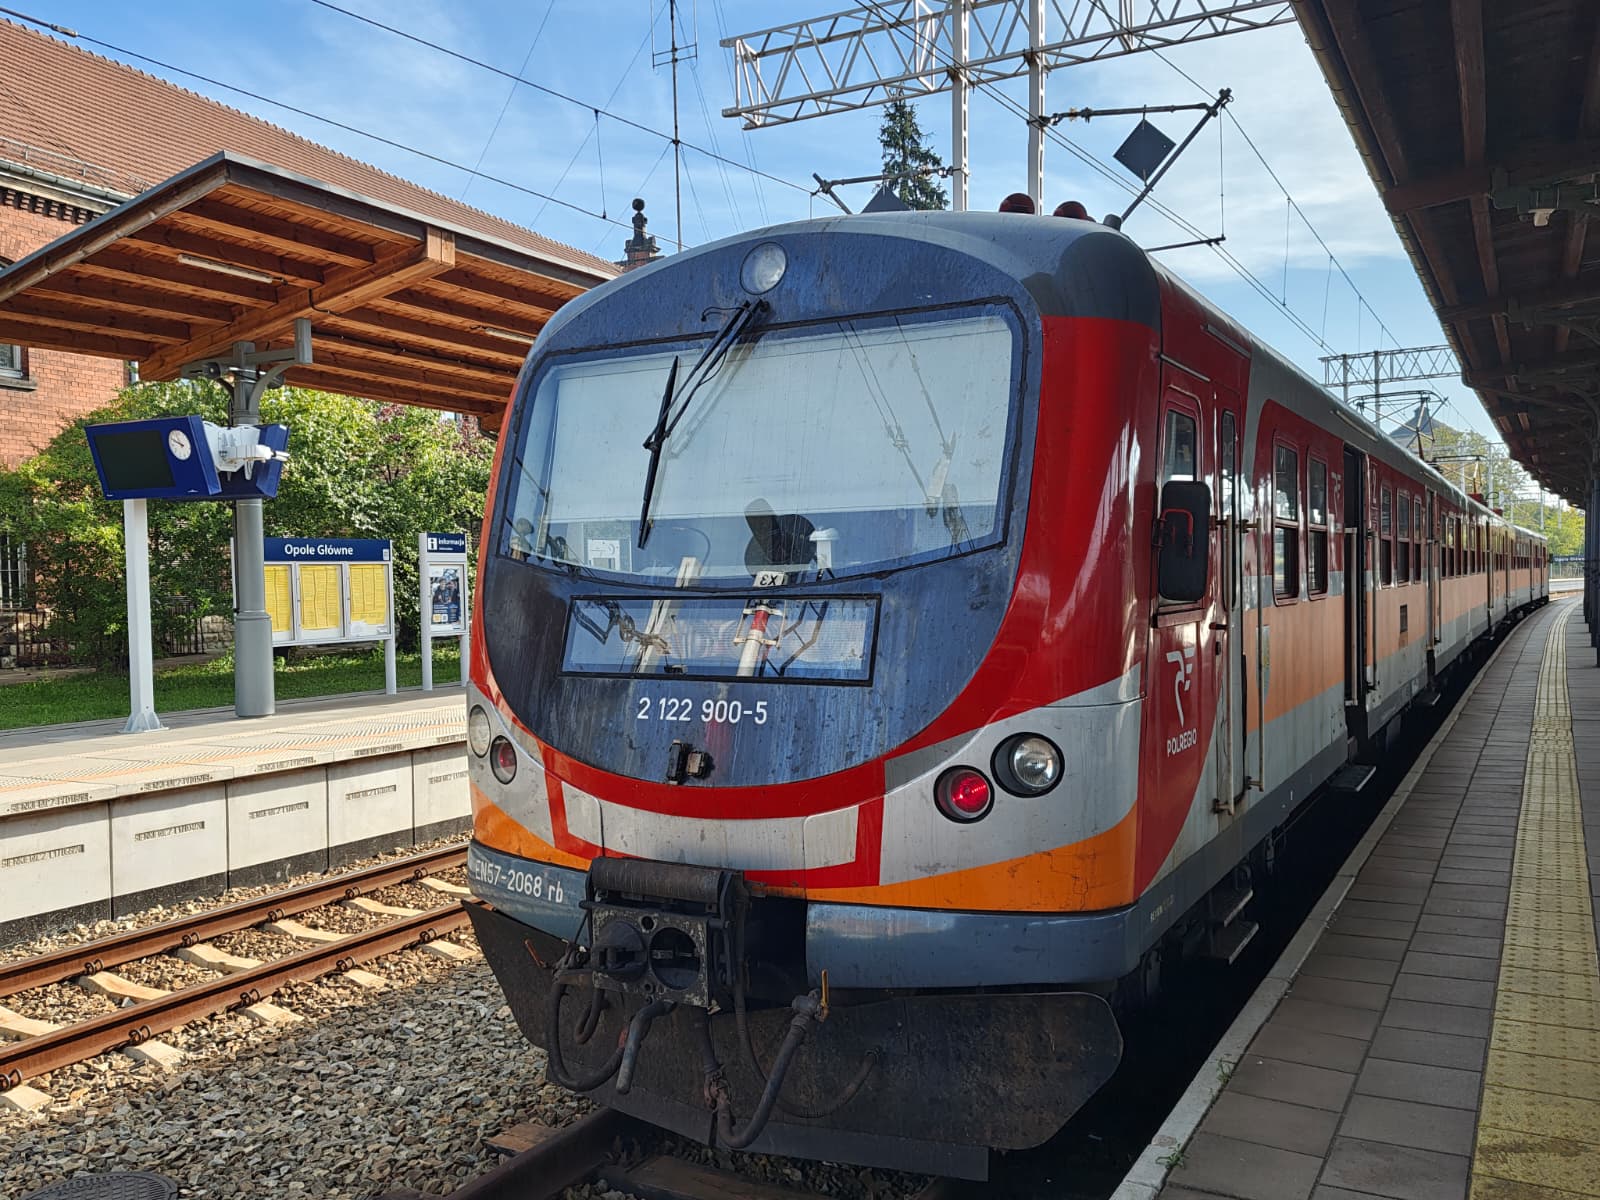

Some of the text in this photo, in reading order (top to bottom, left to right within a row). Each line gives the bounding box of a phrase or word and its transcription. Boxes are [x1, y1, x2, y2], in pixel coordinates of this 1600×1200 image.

[284, 544, 354, 557] Opole Główne
[637, 697, 768, 724] 2 122 900-5
[1166, 728, 1198, 757] POLREGIO
[475, 860, 564, 903] EN57-2068 rb
